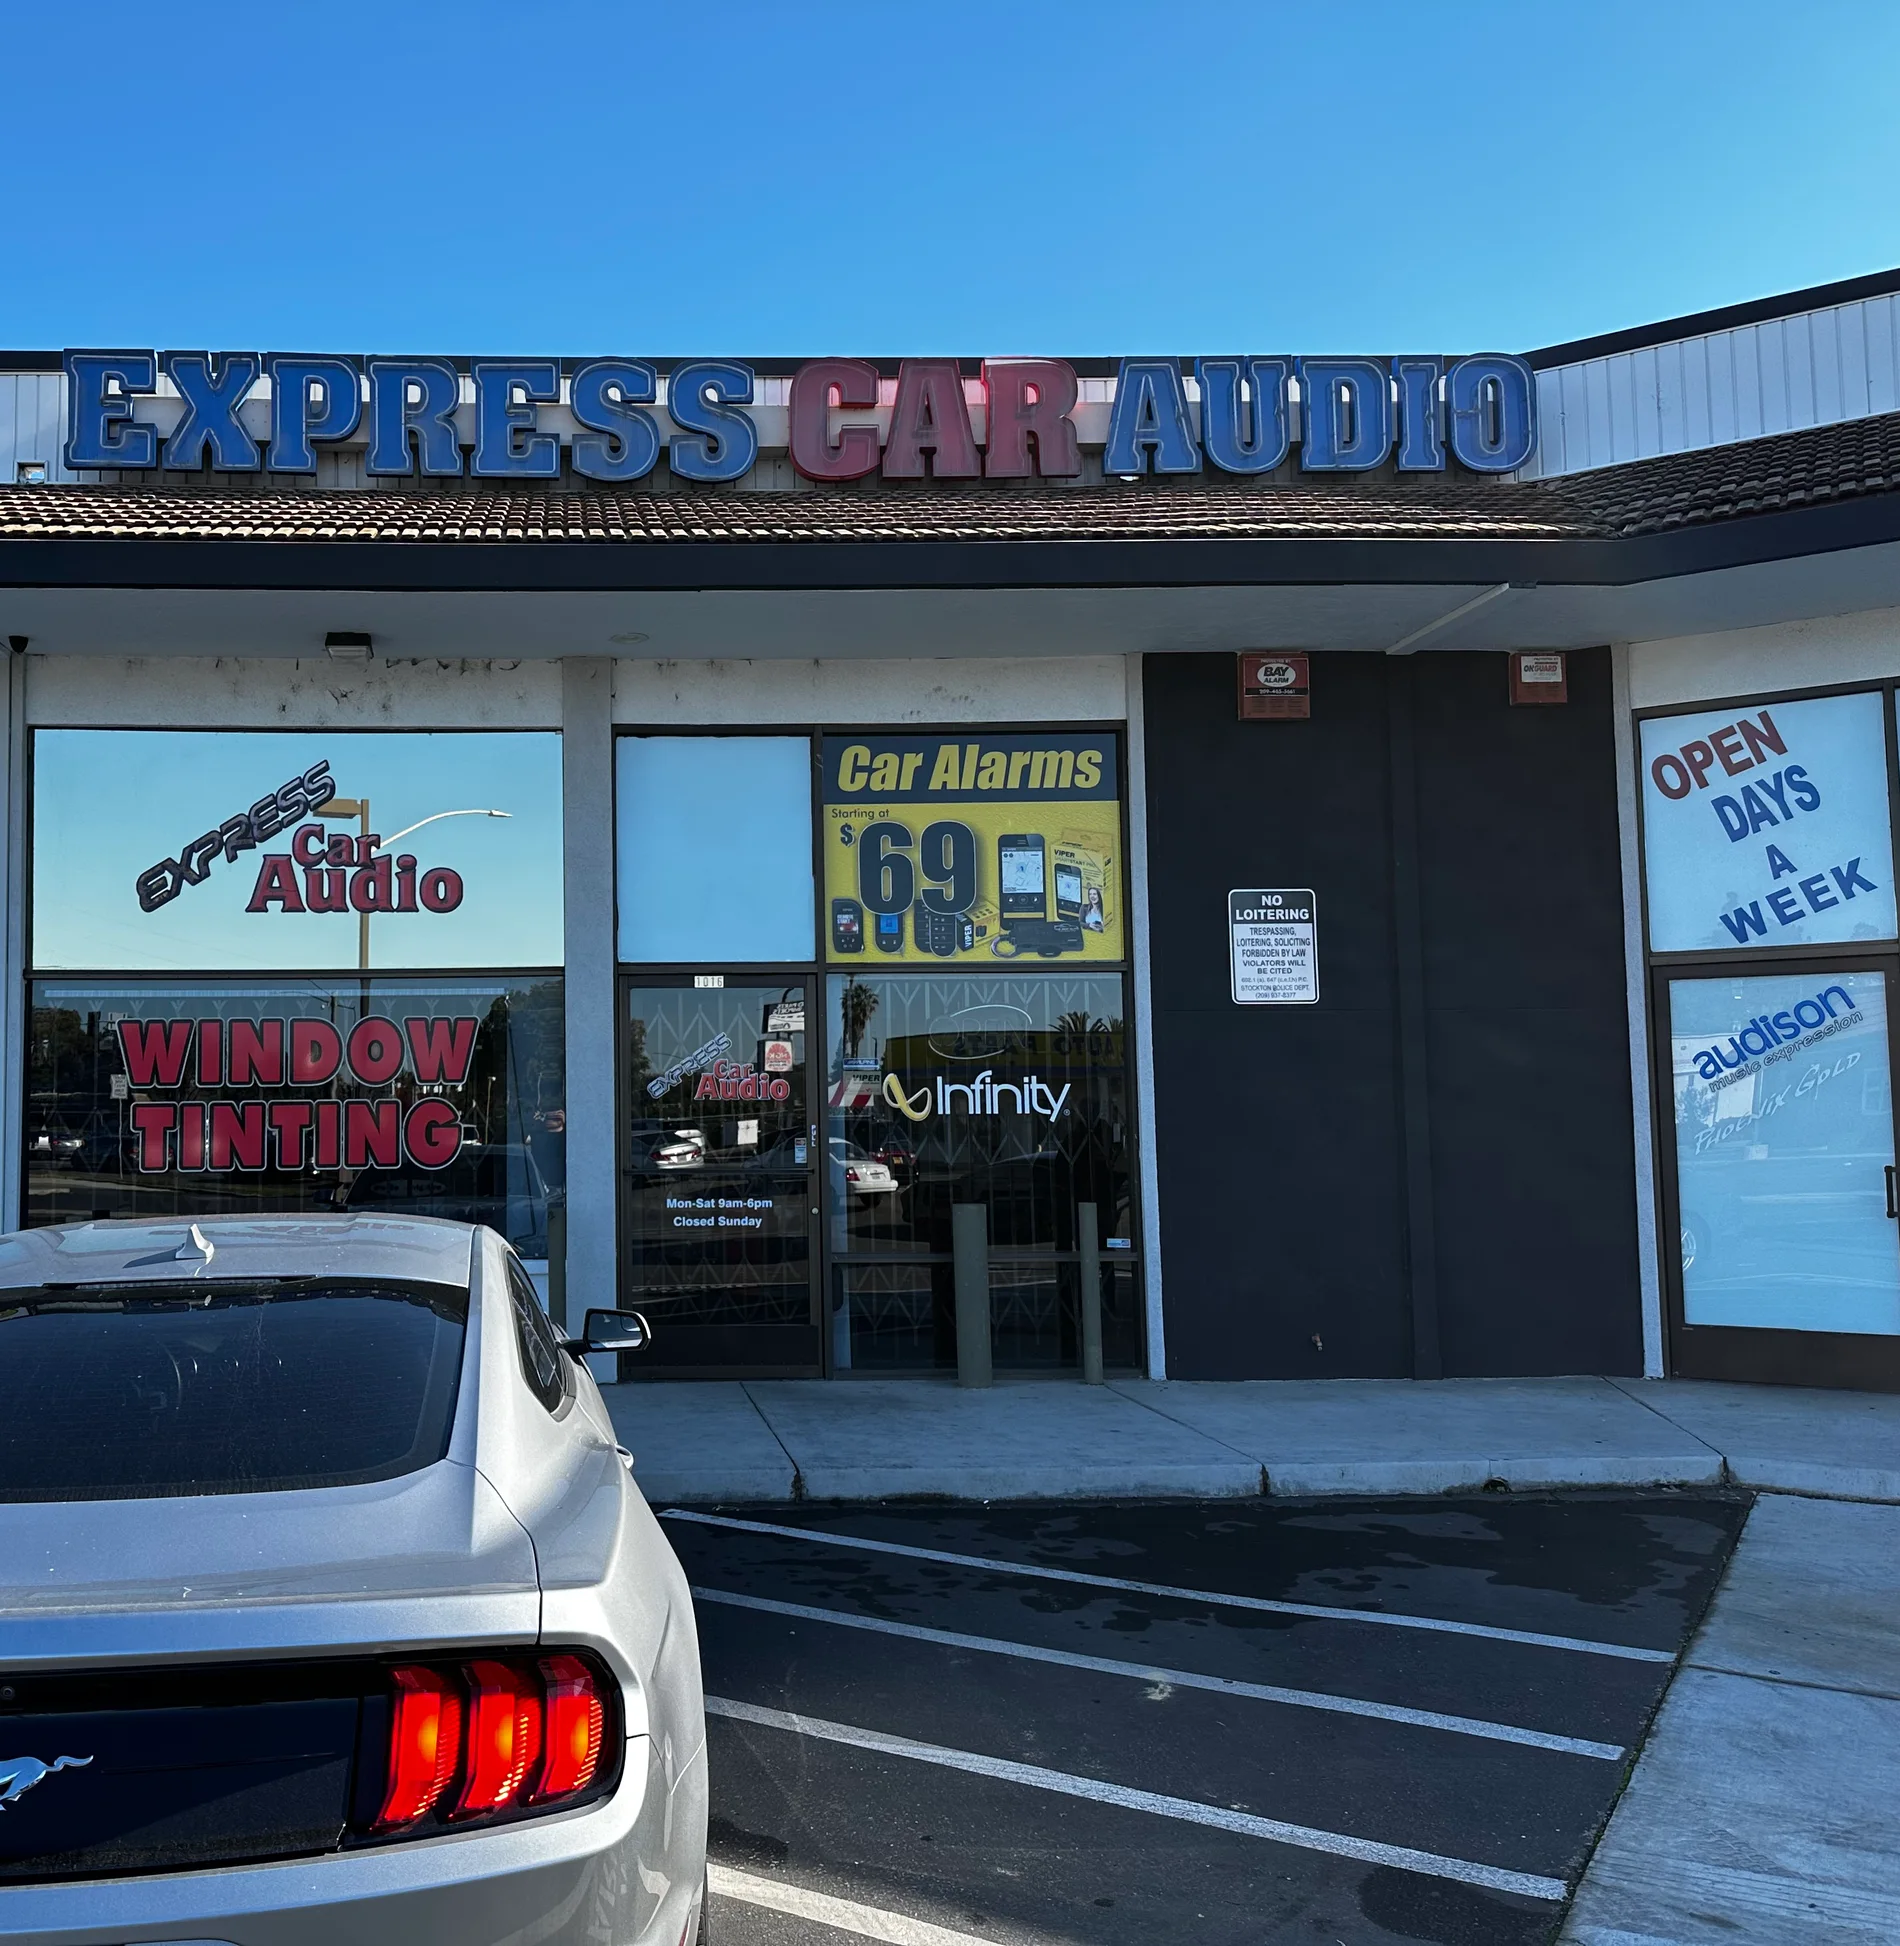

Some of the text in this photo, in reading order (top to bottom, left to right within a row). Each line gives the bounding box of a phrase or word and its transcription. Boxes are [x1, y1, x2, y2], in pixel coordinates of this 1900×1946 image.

[64, 348, 1538, 482] EXPRESS CAR AUDIO
[1264, 667, 1289, 676] BAY
[837, 744, 1103, 792] Car Alarms
[1651, 710, 1788, 800] OPEN
[831, 808, 890, 821] Starting at
[1711, 765, 1821, 843] DAYS
[136, 759, 336, 913] EXPRESS
[291, 823, 381, 868] Car
[1054, 849, 1075, 858] VIPER
[1765, 844, 1798, 880] A
[245, 854, 464, 913] Audio
[1261, 895, 1283, 906] NO
[1719, 857, 1878, 944] WEEK
[1236, 908, 1309, 920] LOITERING
[1250, 927, 1296, 936] TRESPASSING,
[964, 924, 973, 948] VIPER
[1236, 938, 1311, 947] LOITERING, SOLICITING
[1242, 949, 1306, 957] FORBIDDEN BY LAW
[696, 977, 723, 987] 1016
[1692, 986, 1856, 1080] audison
[1708, 1009, 1864, 1092] music expression
[116, 1015, 480, 1089] WINDOW
[647, 1032, 732, 1099] EXPRESS
[713, 1058, 755, 1080] Car
[694, 1073, 790, 1100] Audio
[937, 1070, 1071, 1123] Infinity
[130, 1097, 465, 1173] TINTING
[667, 1199, 773, 1210] Mon-Sat 9am-6pm
[674, 1216, 762, 1229] Closed Sunday
